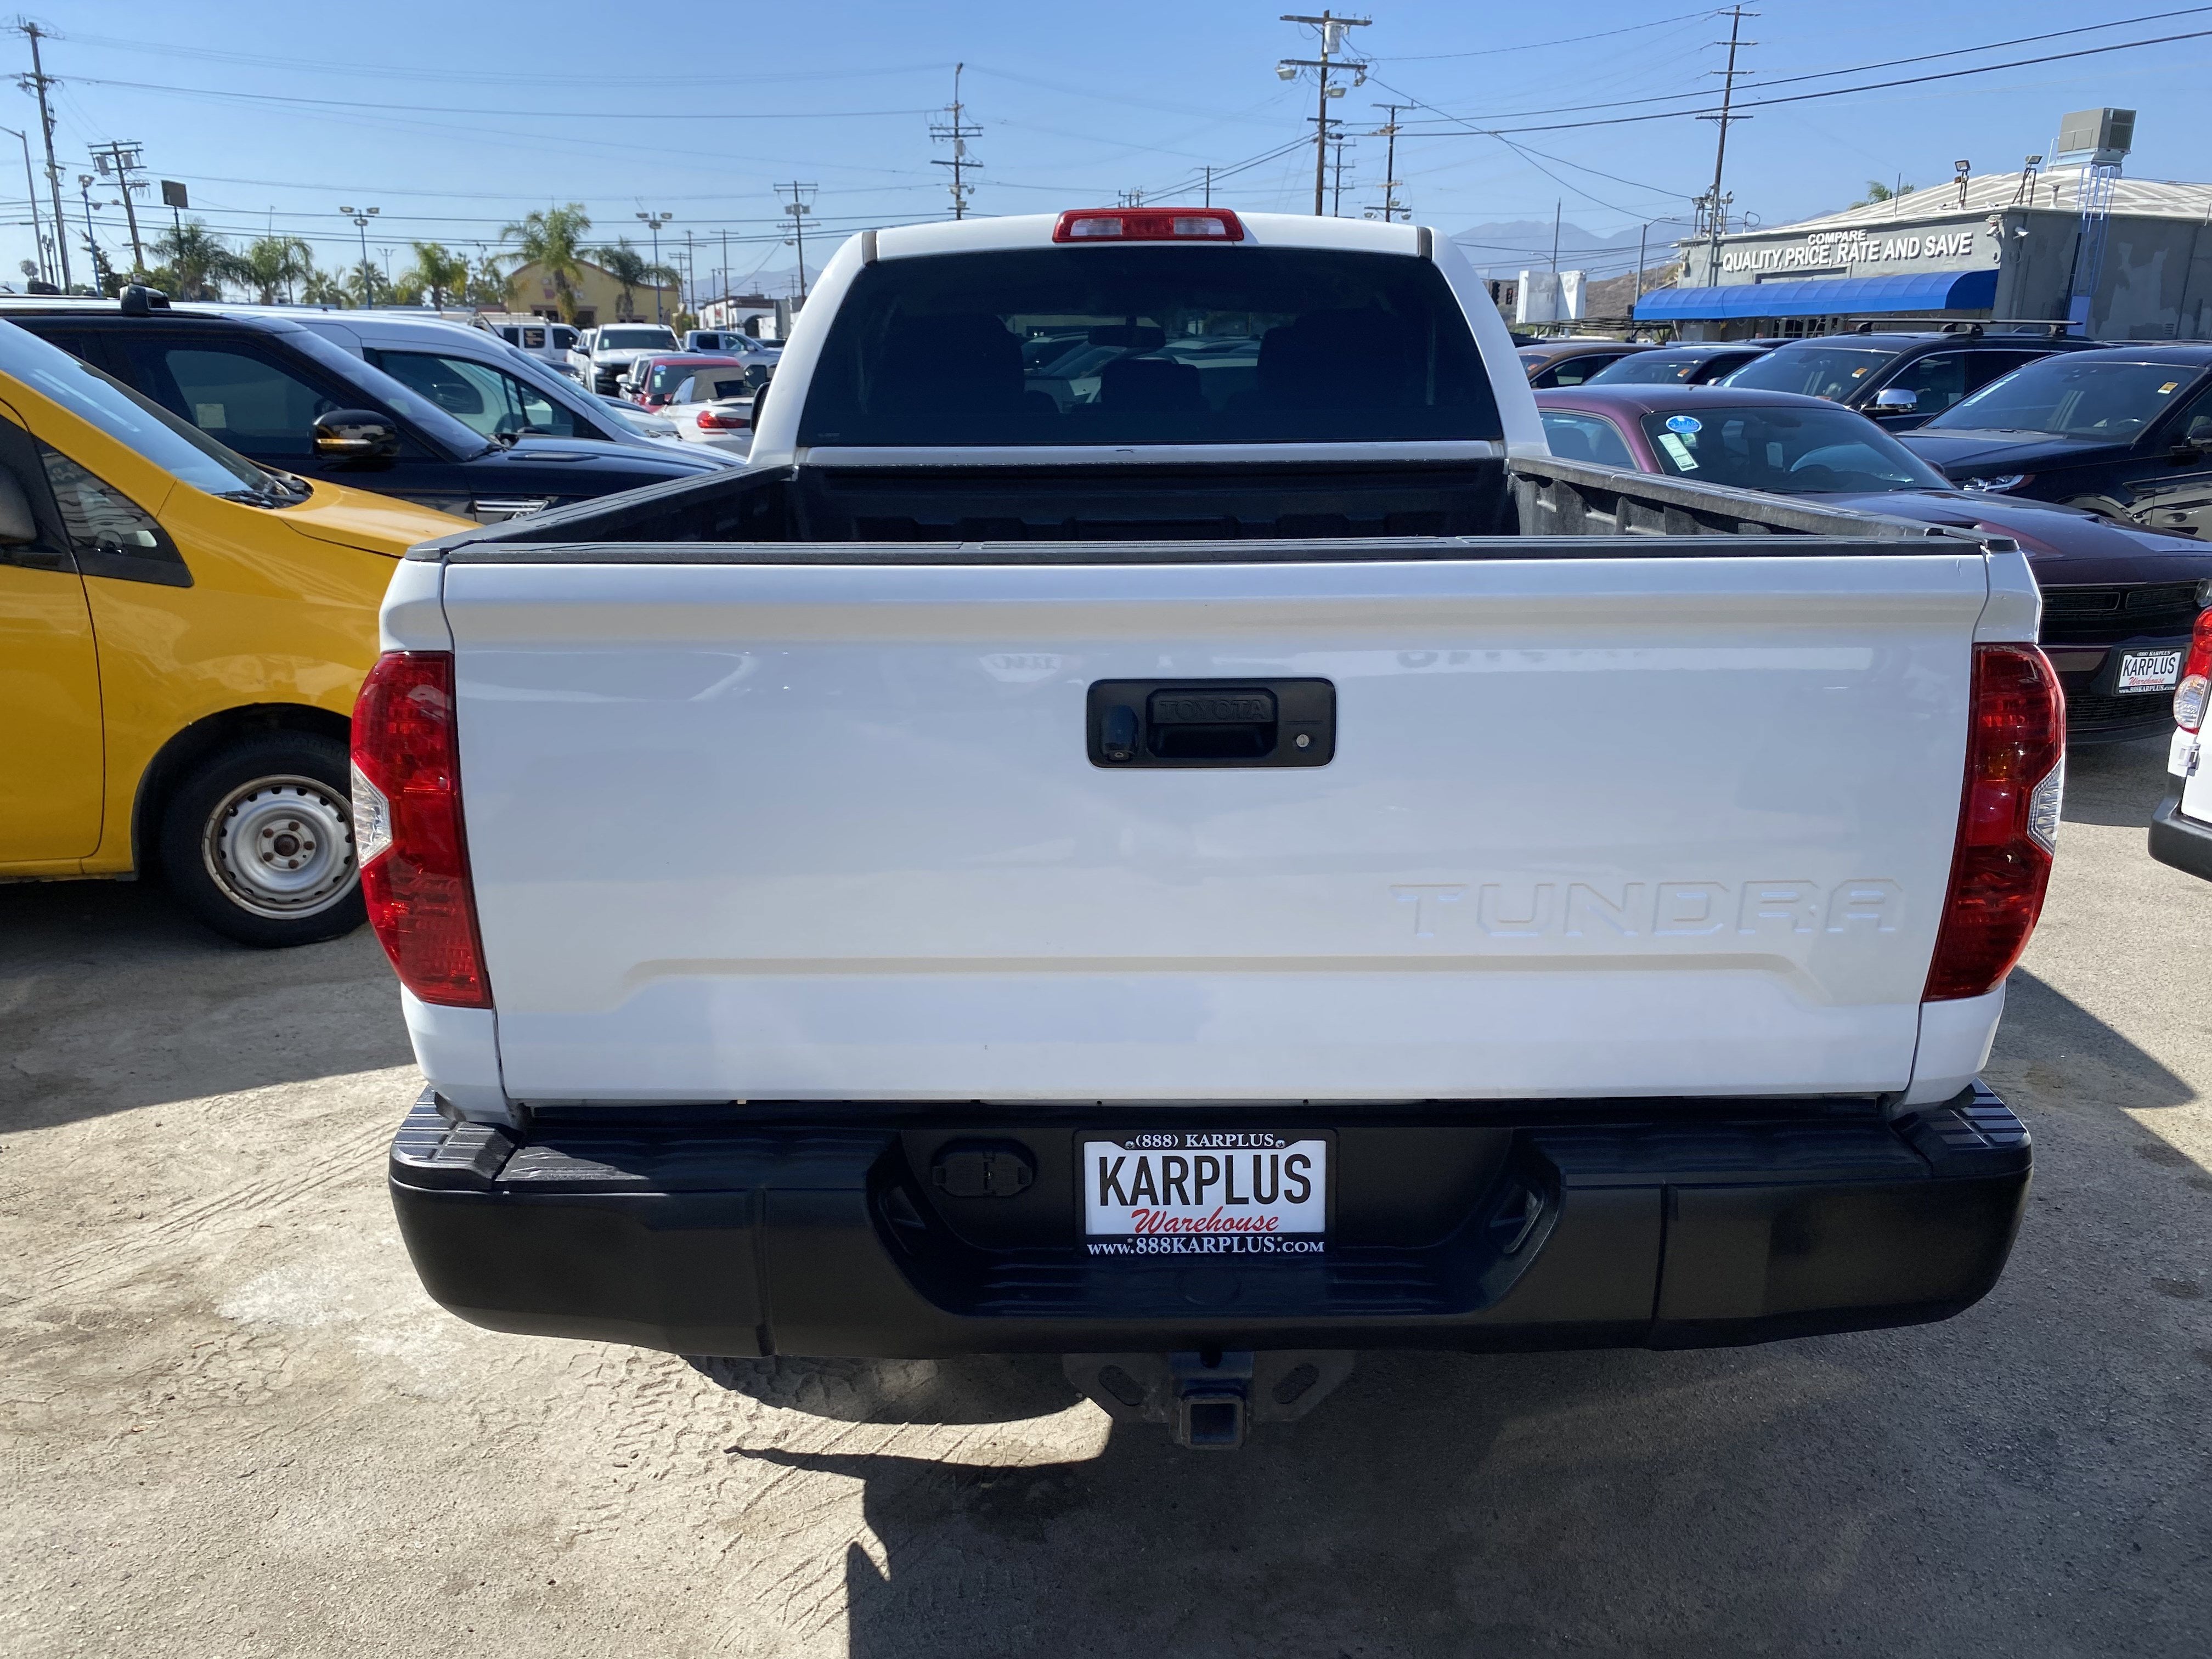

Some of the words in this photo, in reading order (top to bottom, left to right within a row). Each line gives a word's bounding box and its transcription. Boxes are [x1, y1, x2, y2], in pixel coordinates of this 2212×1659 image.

[1808, 229, 1867, 245] COMPARE
[1723, 249, 1782, 272] QUALITY,
[1785, 245, 1832, 267] PRICE,
[1837, 240, 1881, 262] RATE
[1882, 237, 1920, 259] AND
[1924, 232, 1973, 257] SAVE
[2123, 657, 2176, 676] KARPLUS
[2129, 675, 2165, 685] Warehouse
[1158, 699, 1267, 720] TOYOTA
[1389, 878, 1904, 938] TUNDRA
[1135, 1134, 1178, 1148] (888)
[1185, 1133, 1274, 1147] KARPLUS
[1099, 1154, 1312, 1206] KARPLUS
[1131, 1206, 1279, 1234] Warehouse
